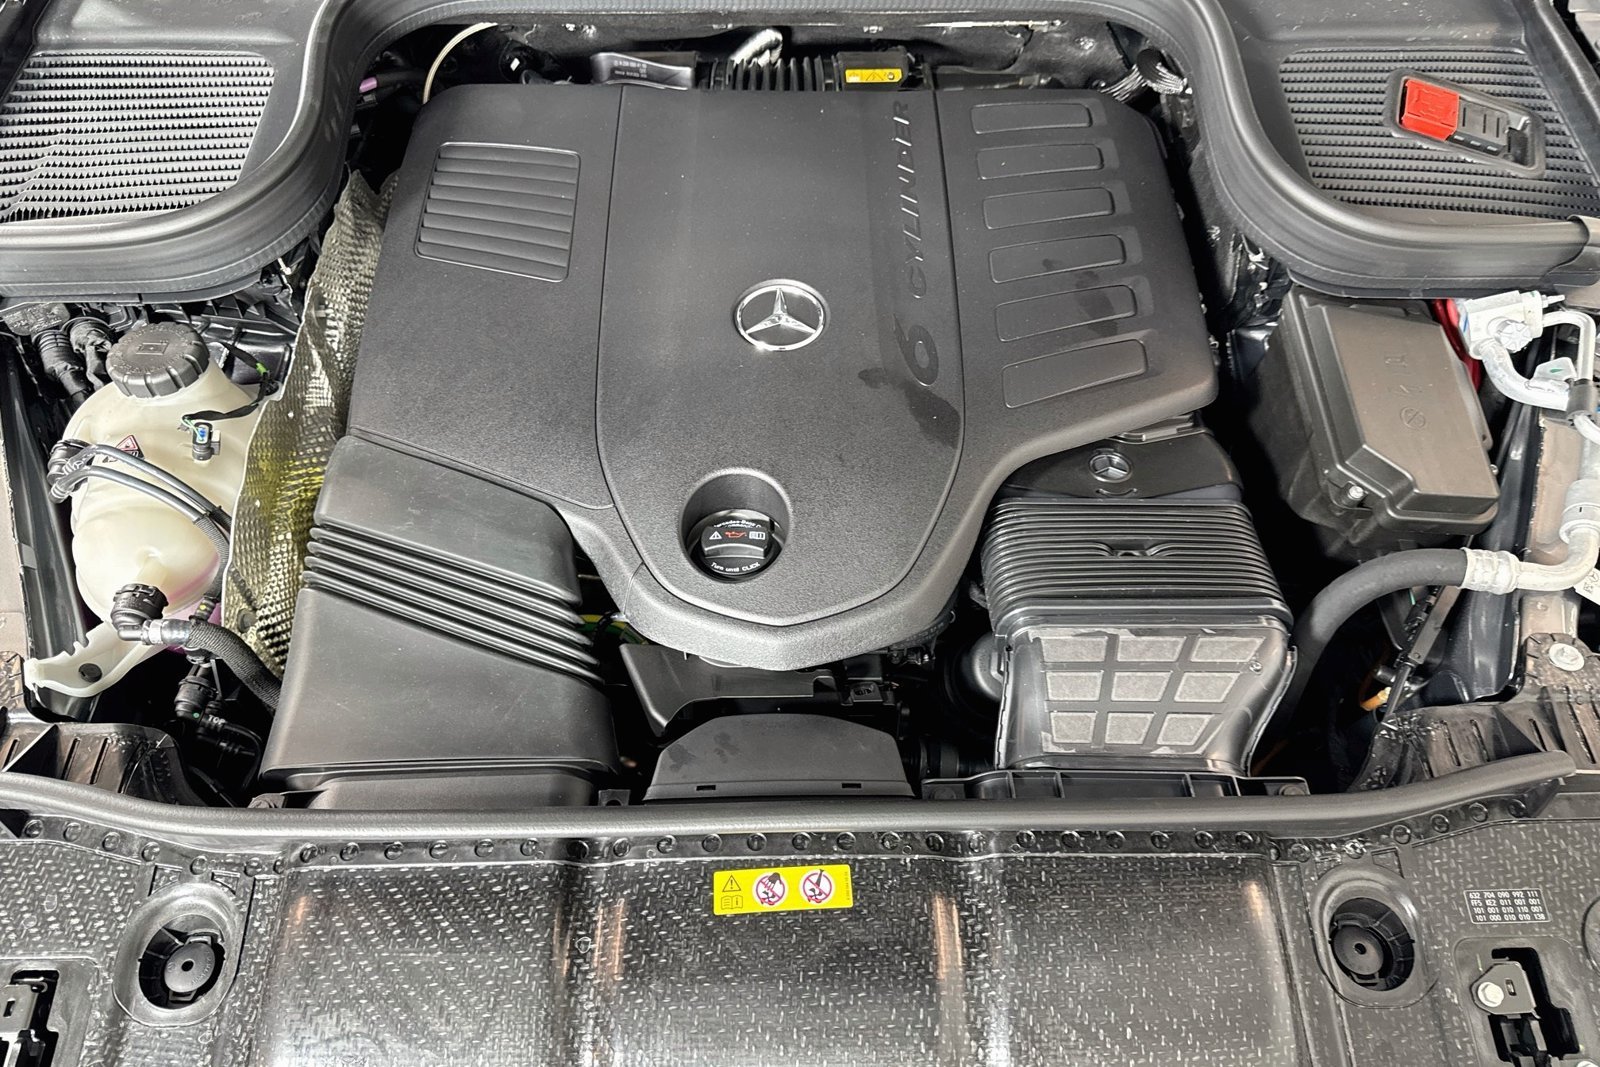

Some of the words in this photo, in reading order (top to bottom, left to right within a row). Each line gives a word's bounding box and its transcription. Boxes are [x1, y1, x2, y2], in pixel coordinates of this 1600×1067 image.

[892, 100, 928, 298] CYLINDER
[892, 313, 939, 386] 6
[711, 562, 724, 571] Turn
[742, 562, 760, 571] CLICK
[208, 714, 226, 725] TOP
